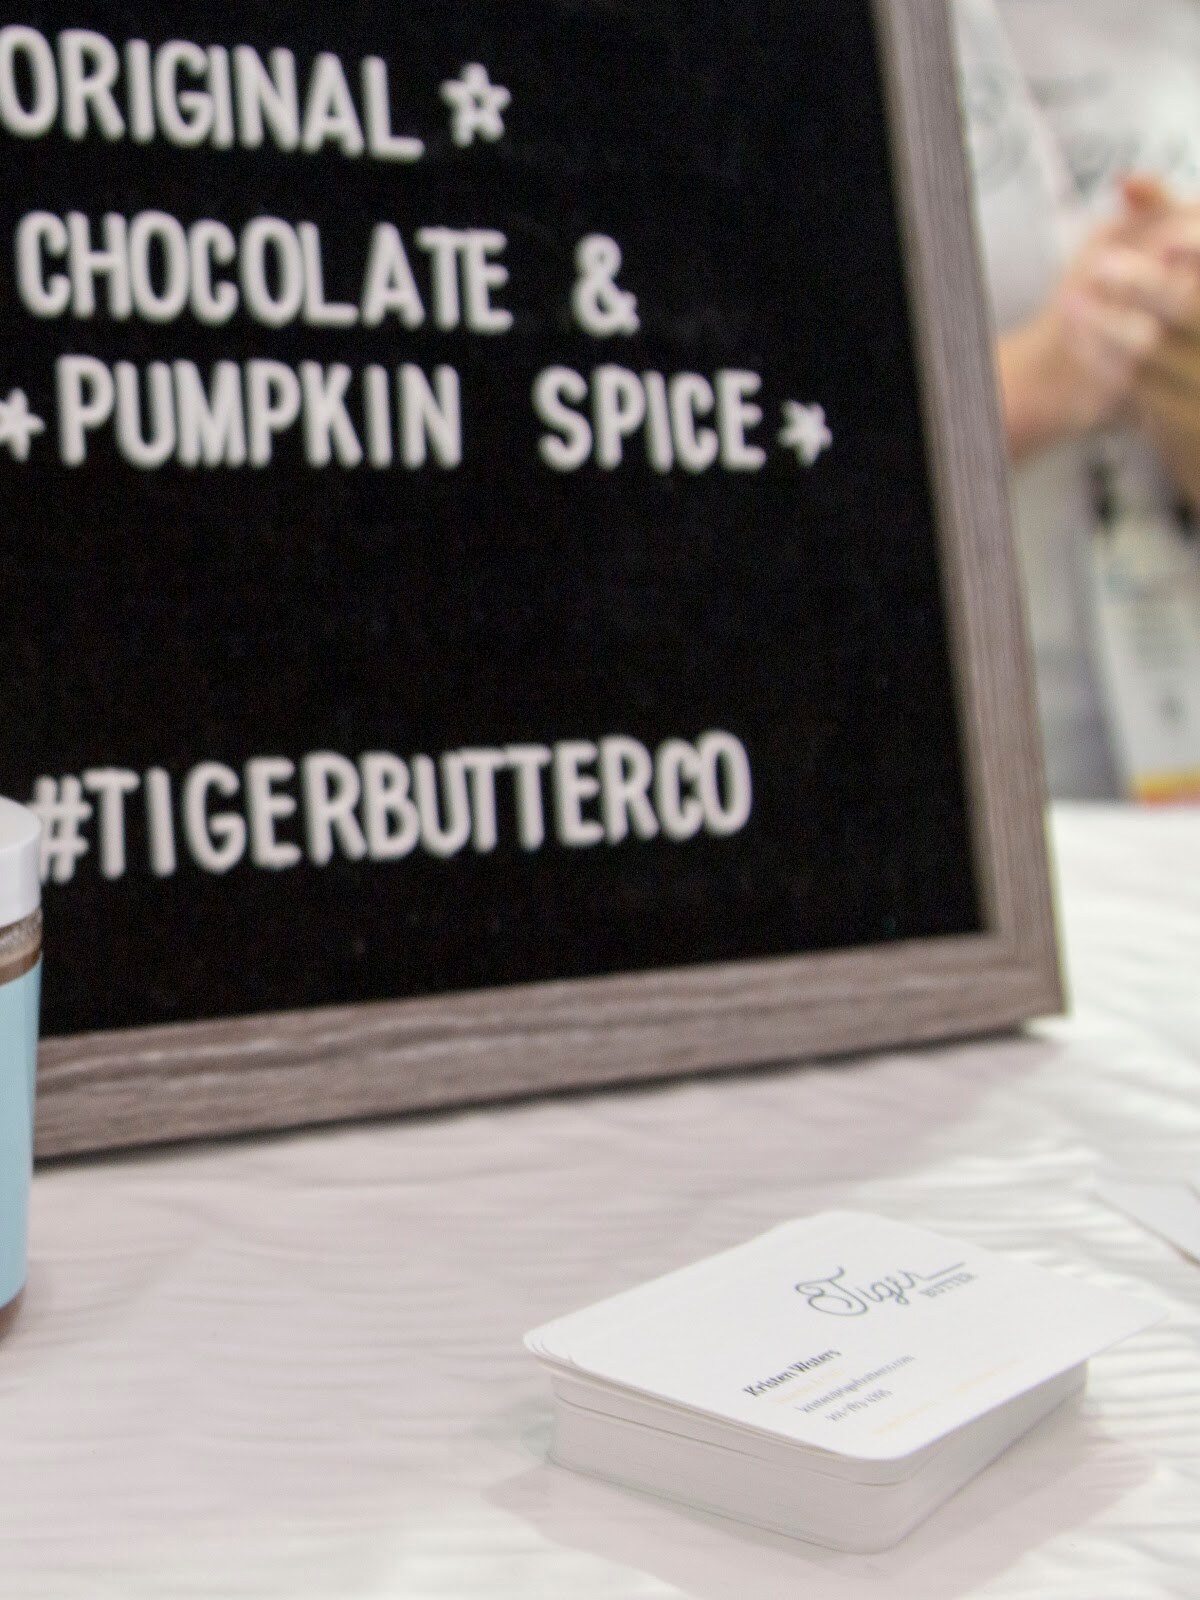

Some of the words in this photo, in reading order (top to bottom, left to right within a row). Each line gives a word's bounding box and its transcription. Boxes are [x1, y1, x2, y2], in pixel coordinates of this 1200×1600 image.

[15, 210, 514, 334] CHOCOLATE
[570, 234, 640, 337] &
[56, 354, 463, 470] PUMPKIN
[533, 365, 767, 473] SPICE
[35, 730, 753, 884] #TIGERBUTTERCO
[743, 1371, 799, 1398] Kristen
